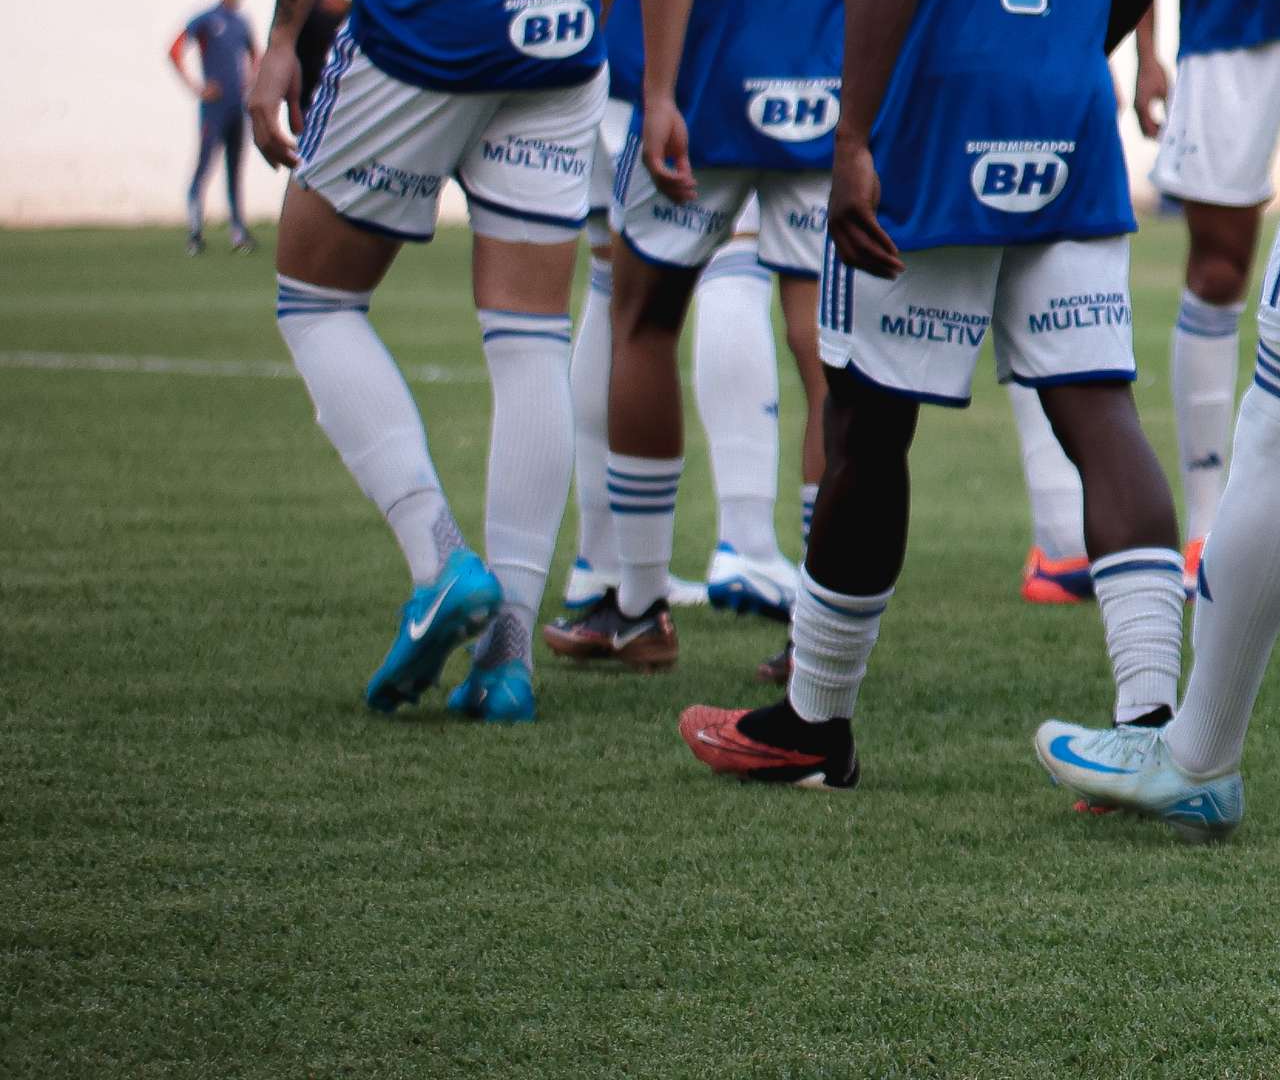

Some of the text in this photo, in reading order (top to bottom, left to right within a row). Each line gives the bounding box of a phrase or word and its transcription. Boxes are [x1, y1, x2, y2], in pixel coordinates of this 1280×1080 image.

[523, 8, 585, 46] BH
[762, 97, 825, 126] BH
[965, 139, 1076, 154] SUPERMERCADOS
[982, 162, 1058, 195] BH
